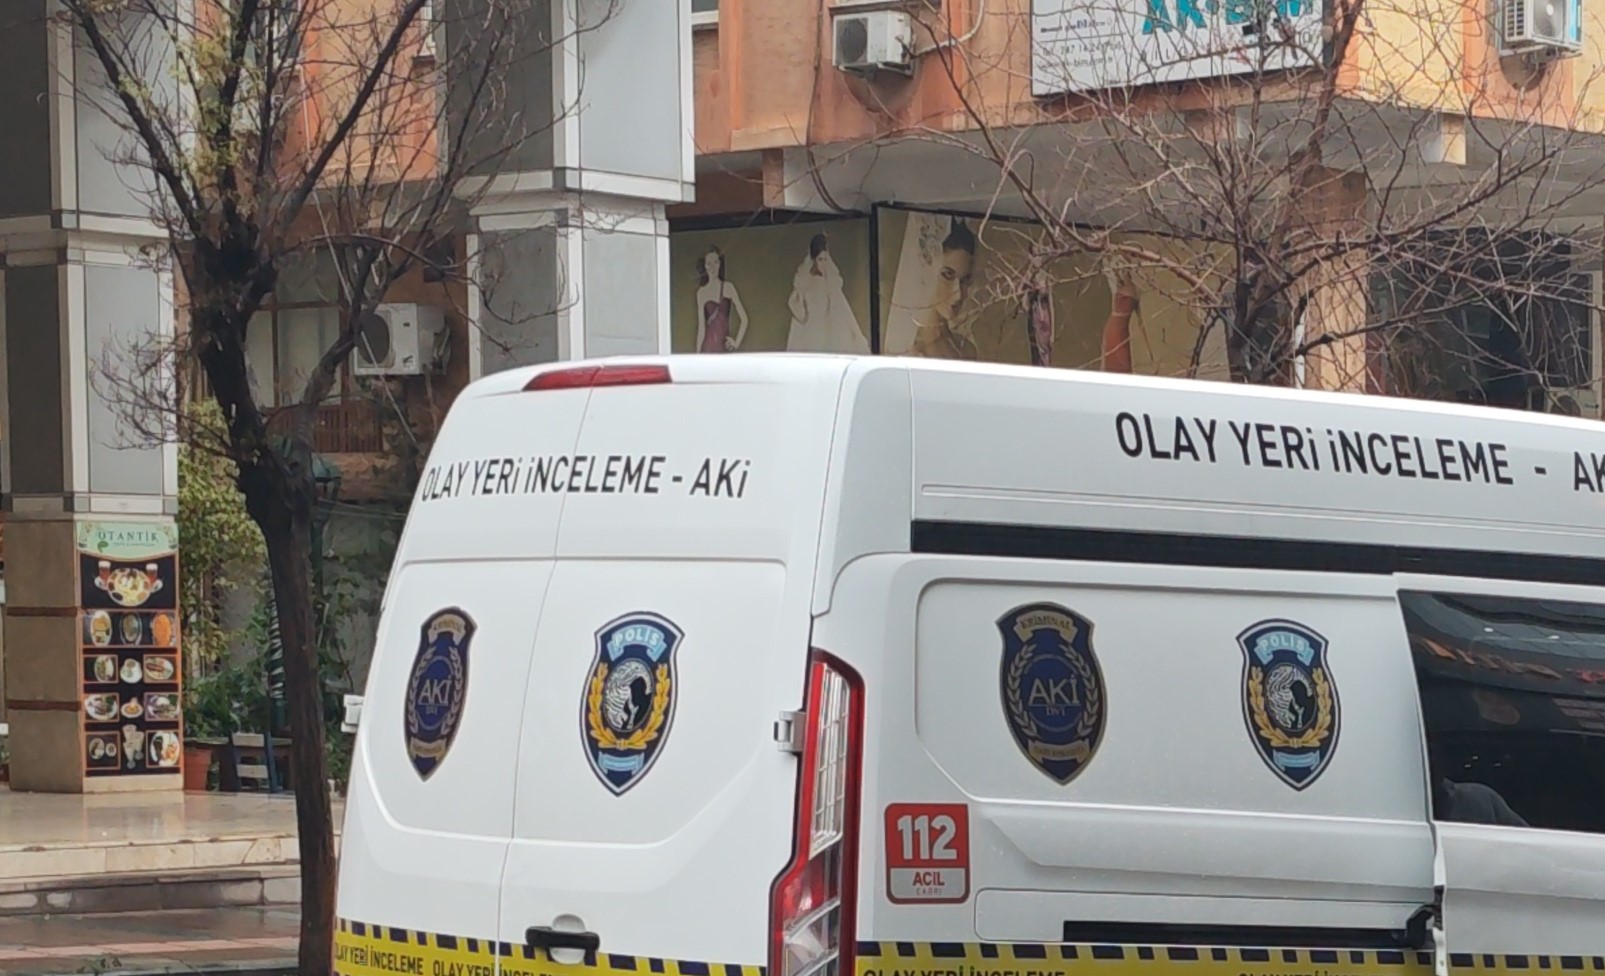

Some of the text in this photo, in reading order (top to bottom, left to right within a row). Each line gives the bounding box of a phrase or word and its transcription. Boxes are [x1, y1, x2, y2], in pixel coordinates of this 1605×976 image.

[1115, 411, 1217, 463] OLAY
[1228, 420, 1321, 471] YERİ
[1329, 428, 1514, 486] İNCELEME
[421, 459, 470, 501] OLAY
[471, 456, 522, 496] YERİ
[524, 455, 666, 493] İNCELEME
[689, 458, 751, 499] AKİ
[1028, 674, 1081, 706] AKİ
[897, 814, 957, 860] 112
[912, 871, 945, 887] ACİL
[370, 946, 424, 976] İNCELEME
